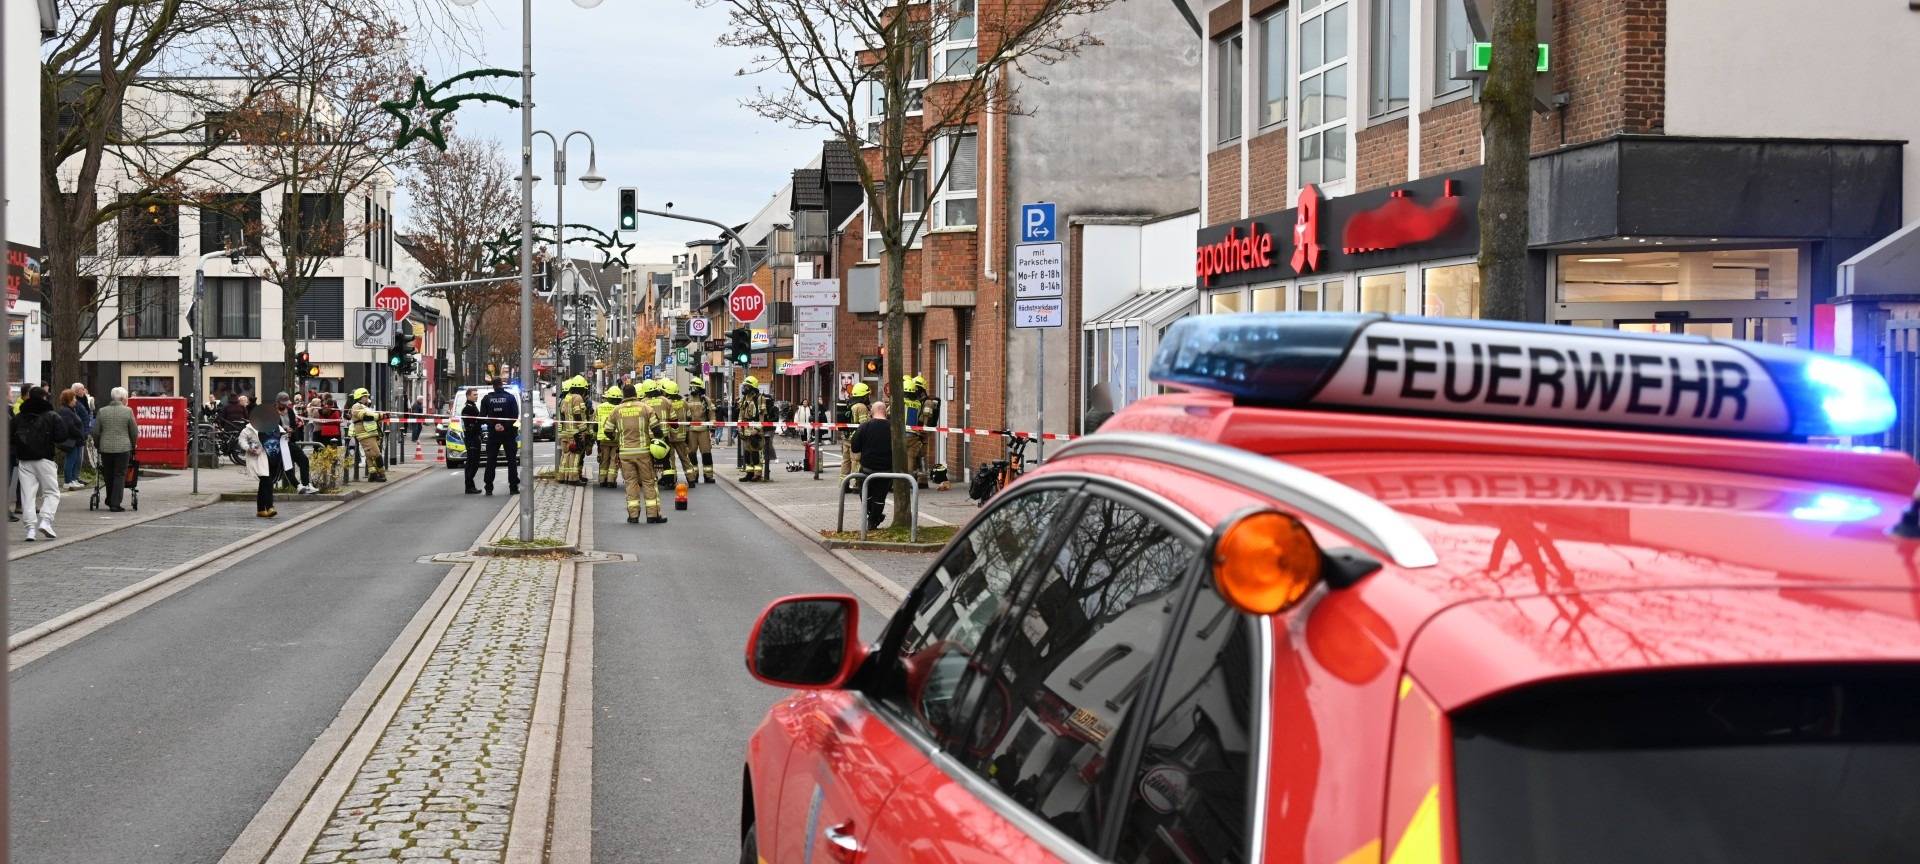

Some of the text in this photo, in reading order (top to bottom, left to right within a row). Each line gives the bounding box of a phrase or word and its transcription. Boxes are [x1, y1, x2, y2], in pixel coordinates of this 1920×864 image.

[1027, 208, 1045, 238] P
[1032, 249, 1045, 257] mit
[1196, 222, 1274, 287] apotheke
[1019, 258, 1059, 266] Parkschein
[1018, 269, 1060, 280] Mo-Fr 8-18h
[1018, 281, 1060, 292] Sa 8-14h
[377, 297, 407, 311] STOP
[732, 295, 761, 312] STOP
[368, 319, 382, 331] 20
[1028, 315, 1033, 323] 2
[753, 332, 769, 340] dm
[1362, 335, 1750, 421] FEUERWEHR
[136, 406, 174, 420] DOMSTADT
[137, 425, 172, 439] SYNDIKAT
